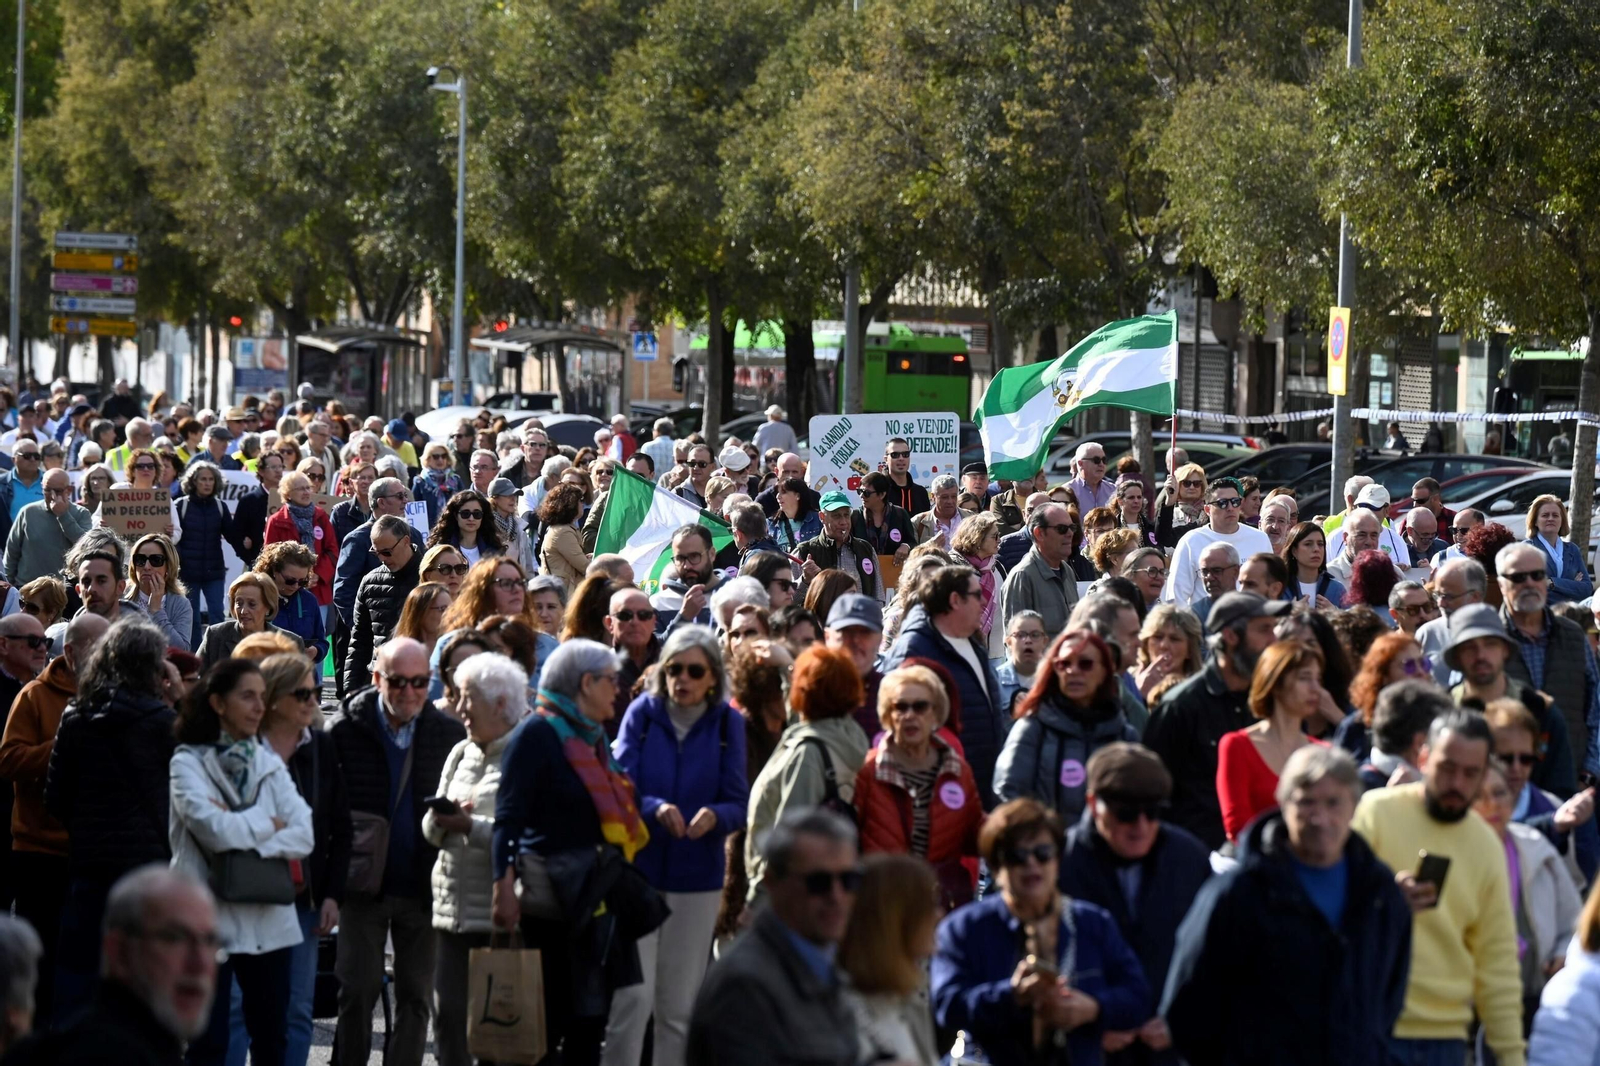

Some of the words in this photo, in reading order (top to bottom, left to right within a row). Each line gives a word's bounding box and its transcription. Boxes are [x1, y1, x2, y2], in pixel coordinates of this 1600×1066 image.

[820, 416, 853, 450] SANIDAD
[885, 420, 900, 435] NO
[903, 422, 914, 434] se
[917, 419, 954, 435] VENDE
[813, 445, 828, 458] La
[830, 437, 861, 469] PÚBLICA
[102, 492, 115, 502] LA
[117, 492, 151, 502] SALUD
[154, 491, 167, 501] ES
[102, 507, 116, 516] UN
[120, 505, 171, 516] DERECHO
[127, 520, 146, 530] NO
